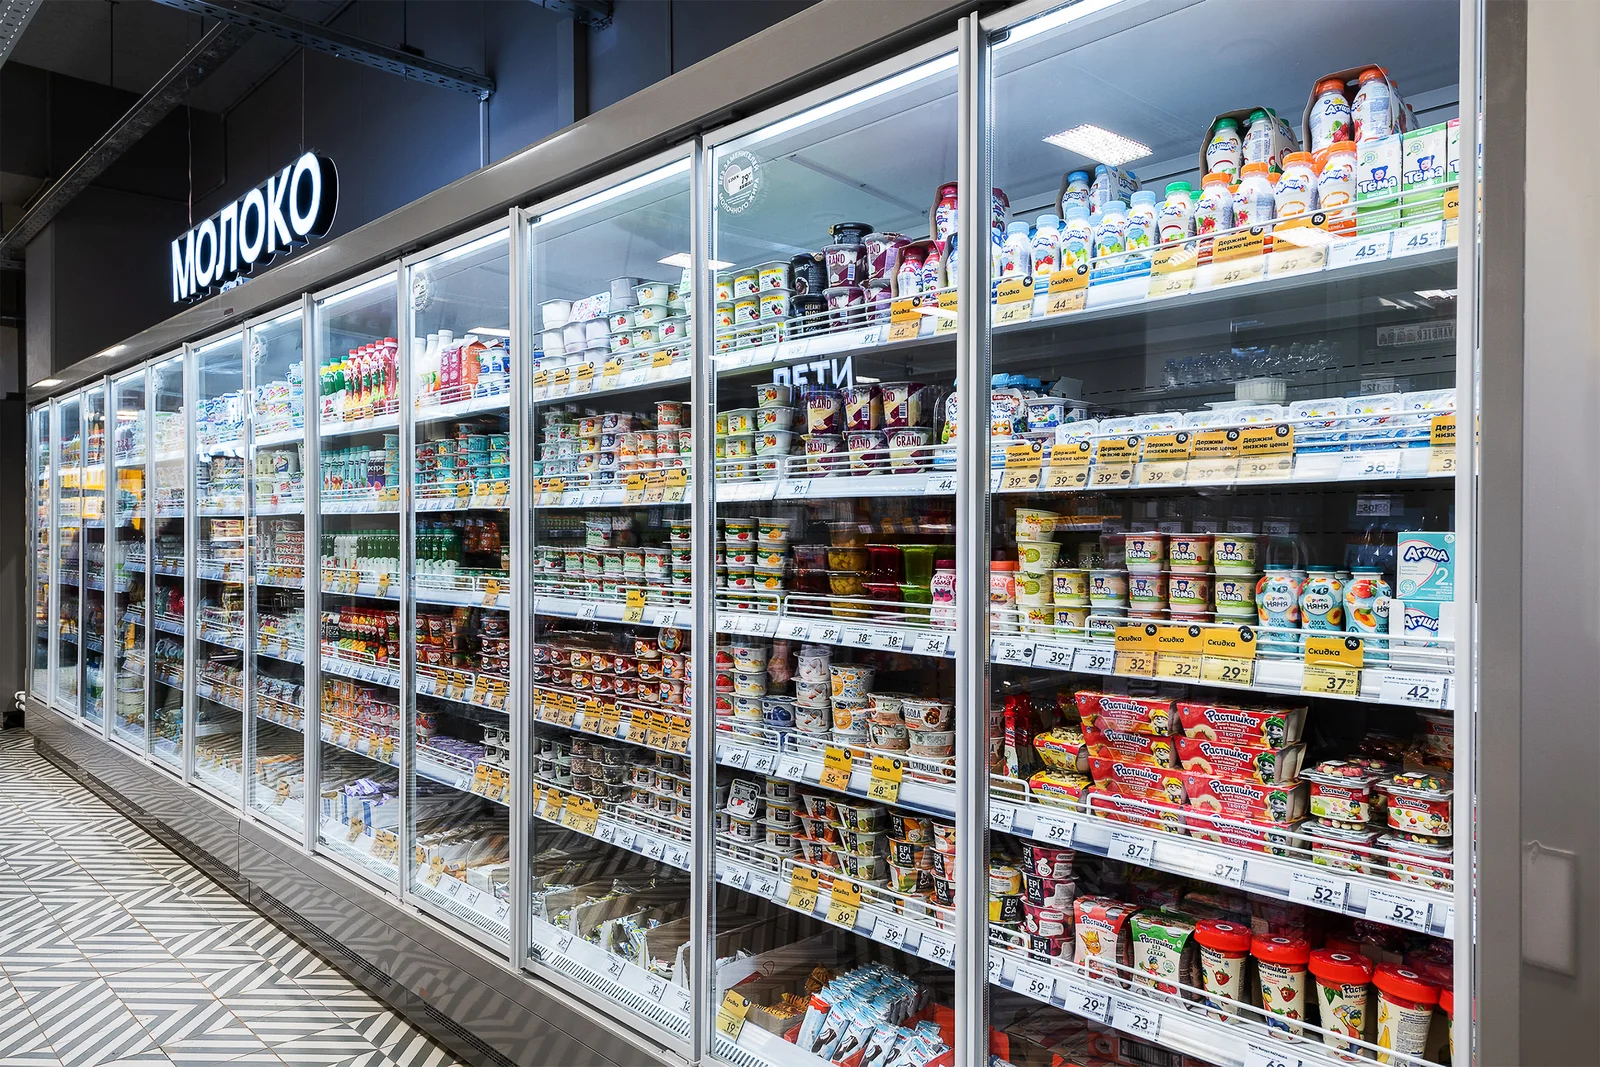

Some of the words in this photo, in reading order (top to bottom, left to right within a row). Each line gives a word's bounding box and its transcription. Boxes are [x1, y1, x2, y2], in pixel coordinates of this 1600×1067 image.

[171, 152, 322, 303] МОЛОКО
[1406, 233, 1428, 247] 45
[1355, 243, 1377, 257] 45
[1280, 259, 1297, 271] 49
[1223, 269, 1240, 281] 49
[1051, 276, 1074, 286] Скидка
[998, 287, 1021, 298] Скидка
[1053, 300, 1067, 309] 44
[1001, 310, 1014, 320] 44
[809, 399, 832, 410] GRAND
[1435, 424, 1456, 433] Держ
[849, 438, 871, 449] GRAND
[896, 436, 922, 447] GRAND
[1147, 441, 1174, 449] Держим
[1195, 438, 1224, 446] Держим
[1242, 435, 1273, 444] Держим
[806, 442, 828, 453] GRAND
[1100, 445, 1125, 454] Держим
[1169, 447, 1187, 455] цены
[1269, 442, 1289, 450] цены
[1053, 449, 1077, 457] Держим
[1054, 476, 1068, 486] 39
[1097, 473, 1112, 483] 39
[1148, 471, 1164, 481] 39
[939, 480, 953, 490] 44
[1008, 477, 1022, 487] 39
[1403, 545, 1450, 563] Агуша
[1435, 567, 1449, 586] 2
[723, 619, 733, 629] 35
[752, 622, 762, 632] 35
[792, 626, 802, 636] 59
[823, 629, 834, 639] 59
[858, 632, 868, 642] 18
[888, 635, 899, 645] 18
[928, 640, 940, 650] 54
[1207, 639, 1236, 648] Скидка
[1004, 649, 1017, 659] 32
[1050, 651, 1065, 663] 39
[1307, 647, 1341, 656] Скидка
[1090, 656, 1105, 667] 39
[1130, 658, 1145, 670] 32
[1175, 664, 1191, 675] 32
[1222, 665, 1241, 679] 29
[1326, 677, 1346, 690] 37
[1407, 685, 1430, 699] 42
[1099, 698, 1148, 715] Растишка
[1204, 708, 1259, 727] Растишка
[1104, 728, 1151, 746] Растишка
[1199, 742, 1253, 762] Растишка
[731, 753, 741, 763] 49
[756, 758, 767, 768] 49
[825, 753, 842, 763] Скидка
[788, 765, 799, 775] 49
[873, 764, 891, 773] Скидка
[1113, 763, 1162, 782] Растишка
[825, 772, 836, 783] 56
[873, 785, 884, 795] 48
[1209, 780, 1263, 800] Растишка
[1319, 784, 1351, 798] Растишка
[1396, 796, 1431, 811] Растишка
[992, 813, 1006, 824] 42
[1049, 826, 1065, 838] 59
[623, 835, 631, 844] 44
[651, 846, 659, 855] 44
[1127, 843, 1144, 856] 87
[673, 854, 682, 863] 44
[1214, 863, 1233, 877] 87
[731, 874, 742, 884] 44
[793, 874, 809, 883] Скидка
[760, 883, 770, 893] 44
[833, 886, 850, 896] Скидка
[1028, 888, 1042, 898] CA
[1313, 886, 1334, 901] 52
[799, 896, 810, 908] 69
[837, 911, 850, 923] 69
[1392, 905, 1414, 921] 52
[1081, 915, 1115, 932] Растишка
[885, 929, 898, 941] 59
[1138, 933, 1177, 951] Растишка
[932, 945, 946, 958] 59
[1030, 980, 1045, 993] 59
[1082, 997, 1099, 1010] 29
[726, 1021, 736, 1032] 19
[1132, 1015, 1148, 1029] 23
